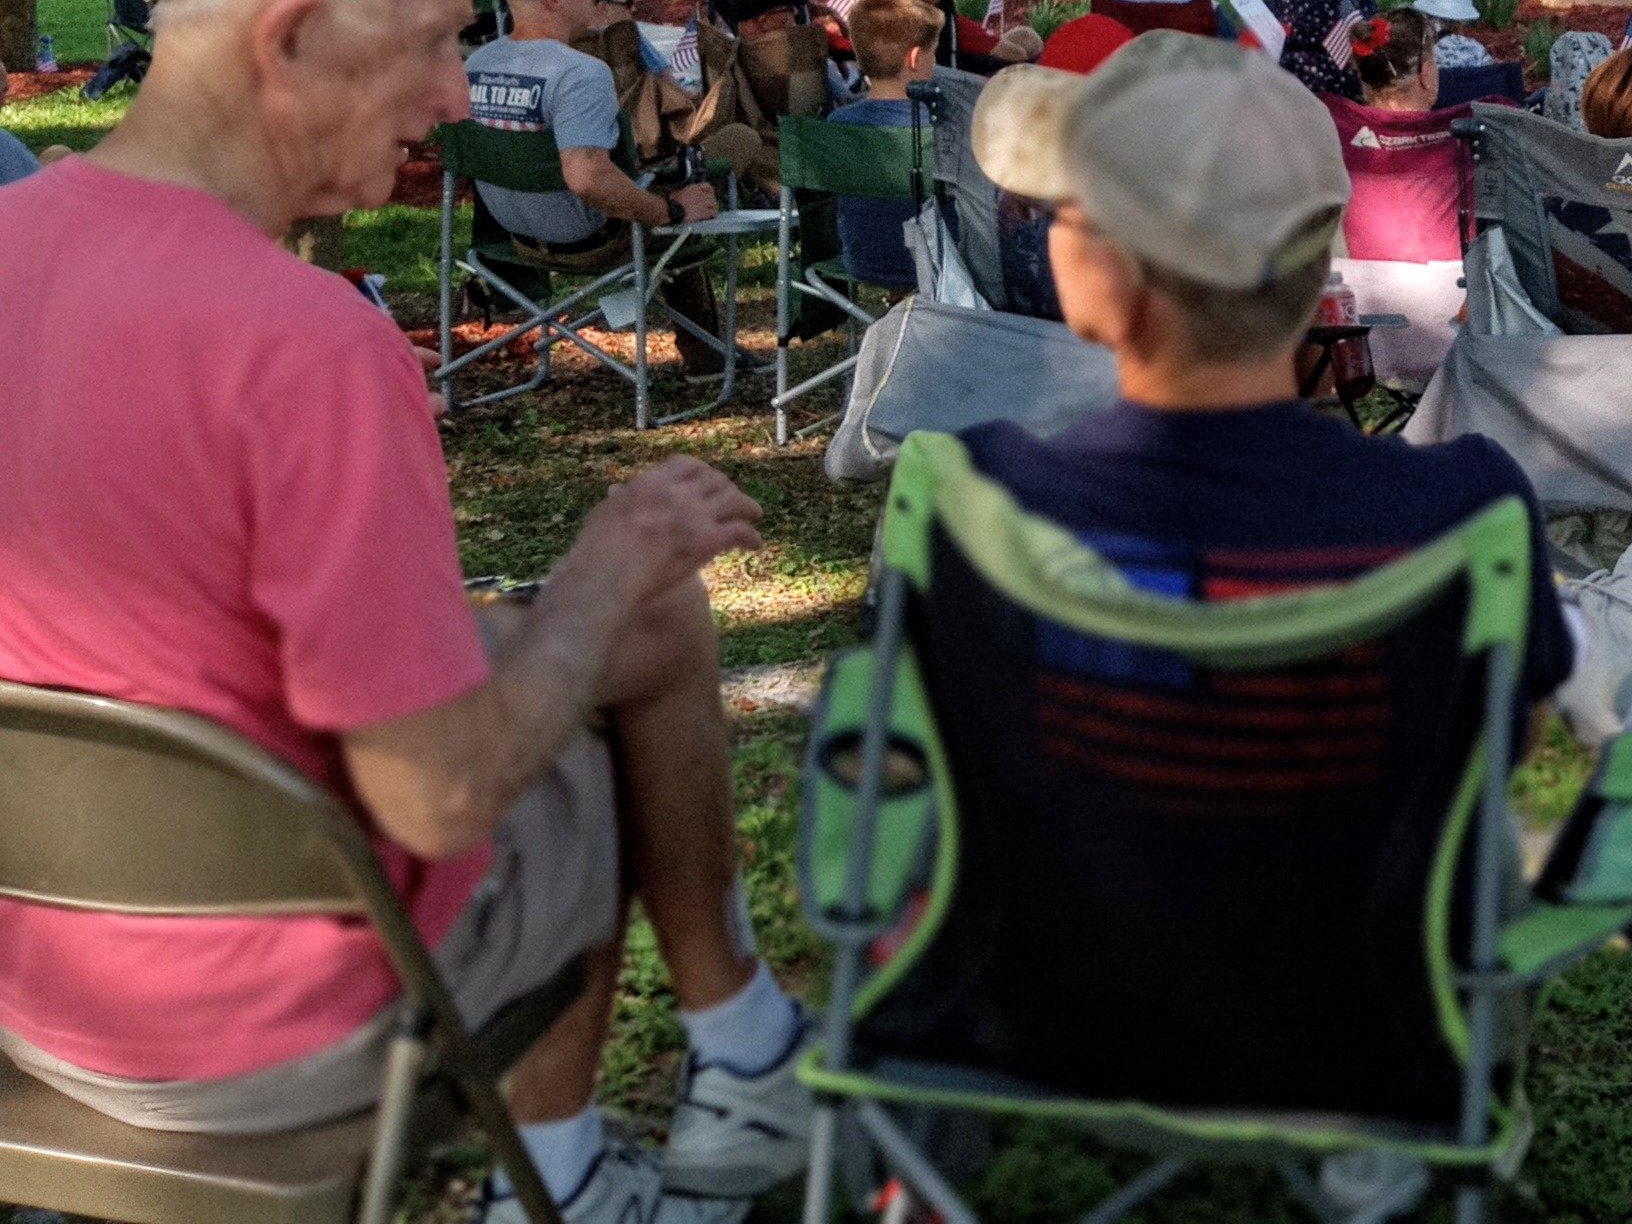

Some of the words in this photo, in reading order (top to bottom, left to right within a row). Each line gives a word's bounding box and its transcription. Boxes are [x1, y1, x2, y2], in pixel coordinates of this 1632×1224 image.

[470, 84, 489, 104] AIL
[491, 85, 507, 105] TO
[506, 84, 541, 110] ZERO
[1379, 134, 1418, 147] OZARK
